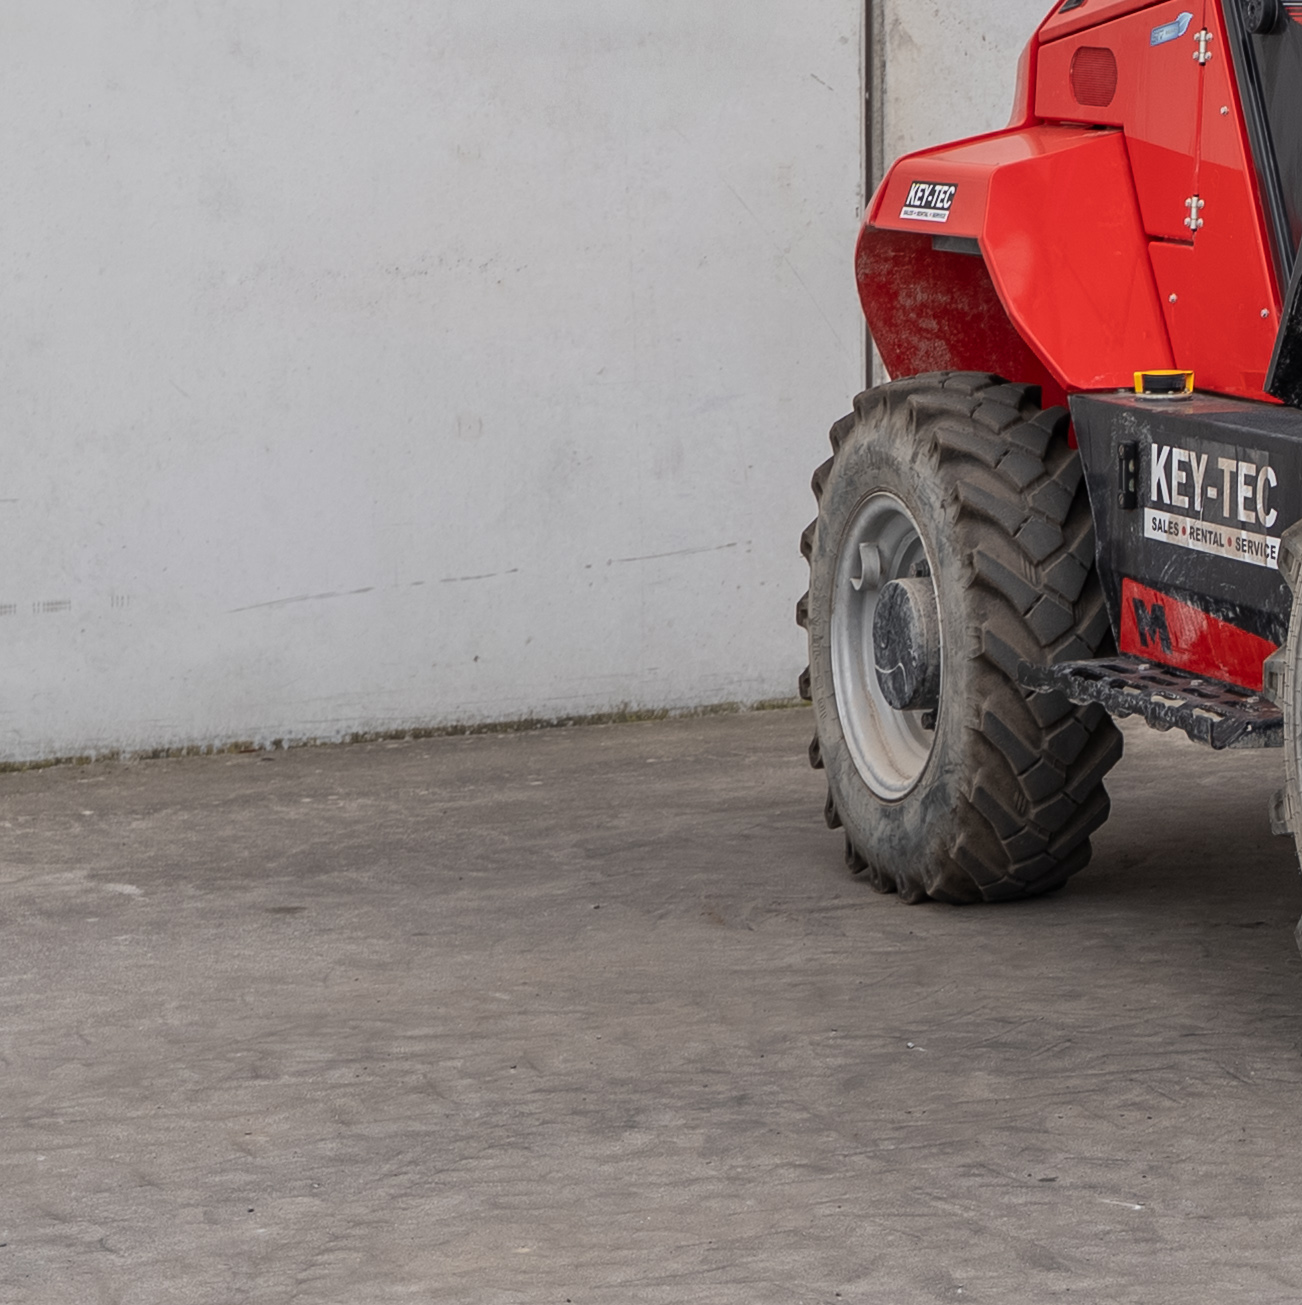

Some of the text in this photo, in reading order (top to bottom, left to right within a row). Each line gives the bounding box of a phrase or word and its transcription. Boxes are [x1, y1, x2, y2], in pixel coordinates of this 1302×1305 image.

[905, 182, 957, 209] KEY-TEC
[1150, 442, 1278, 528] KEY-TEC
[1151, 516, 1277, 560] SALES RENTAL SERVICE
